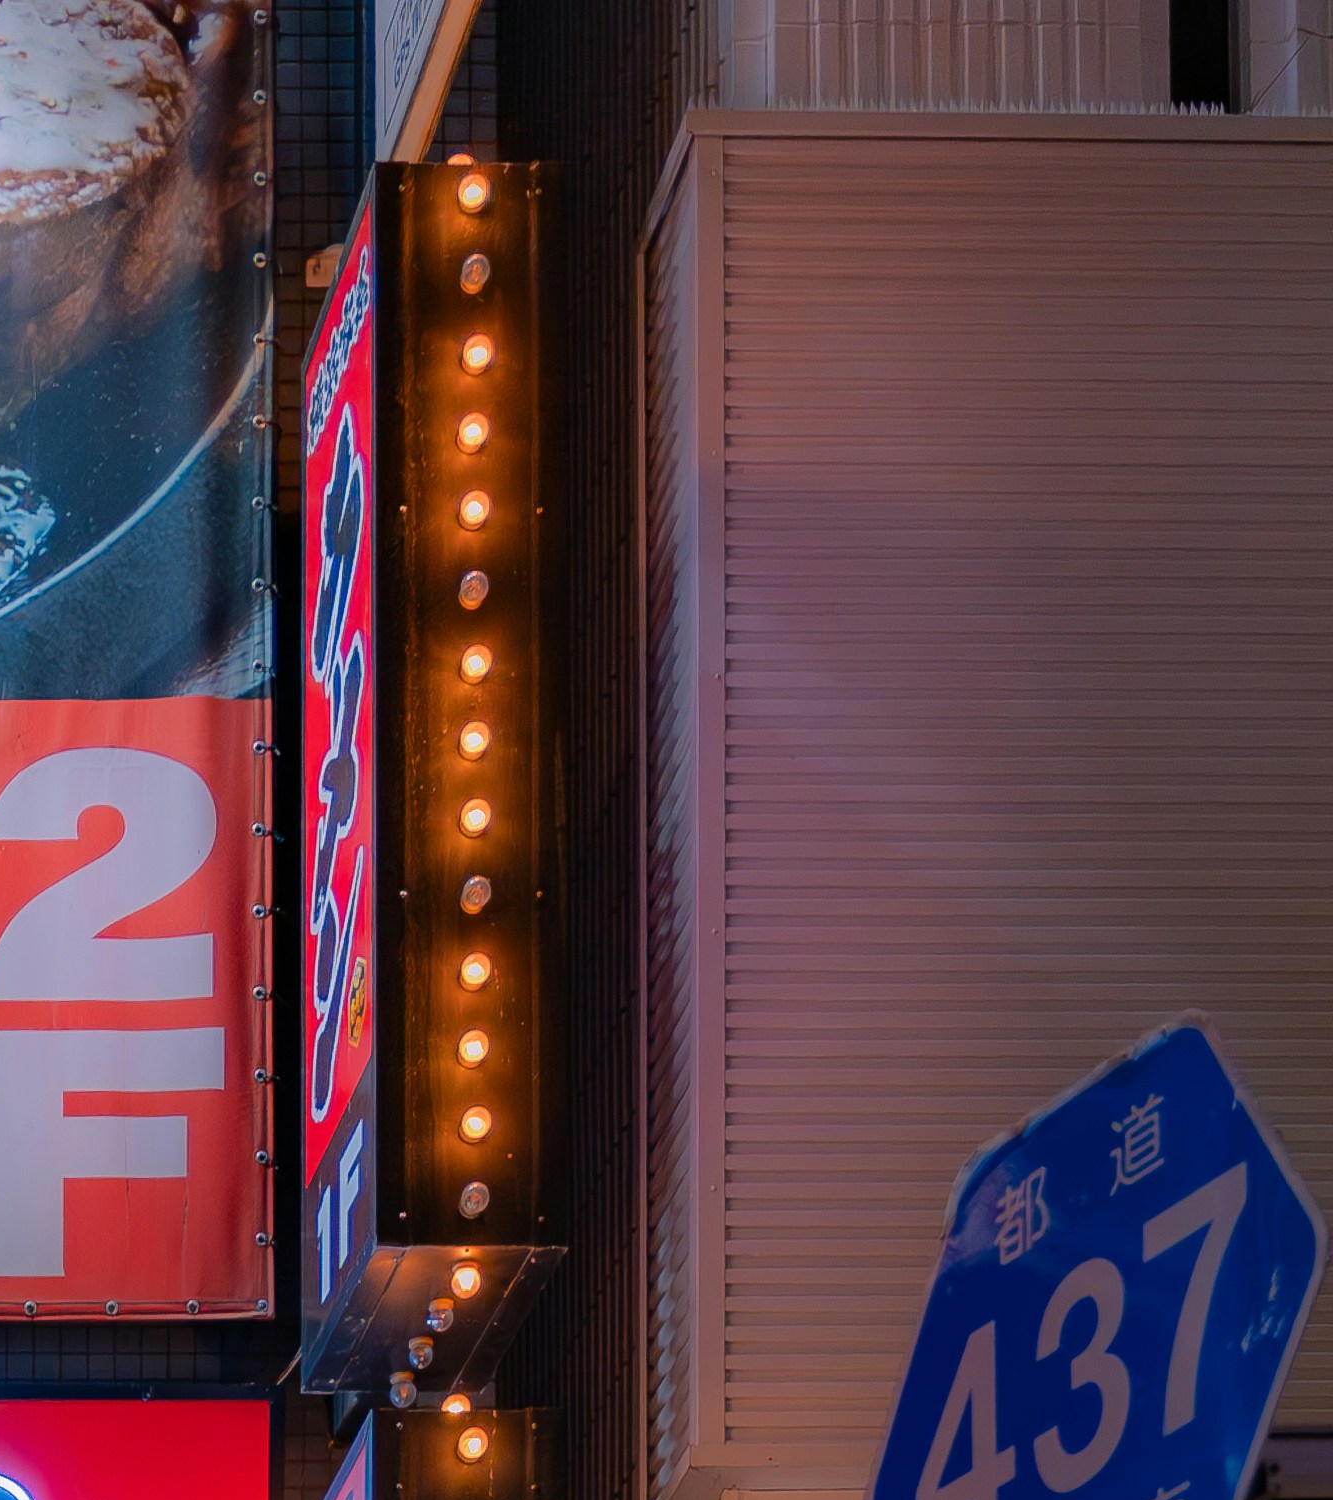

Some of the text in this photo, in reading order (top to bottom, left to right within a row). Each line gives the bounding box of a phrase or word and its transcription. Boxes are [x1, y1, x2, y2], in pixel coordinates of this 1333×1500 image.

[310, 402, 365, 1124] ラーメン
[317, 1119, 363, 1304] 1F
